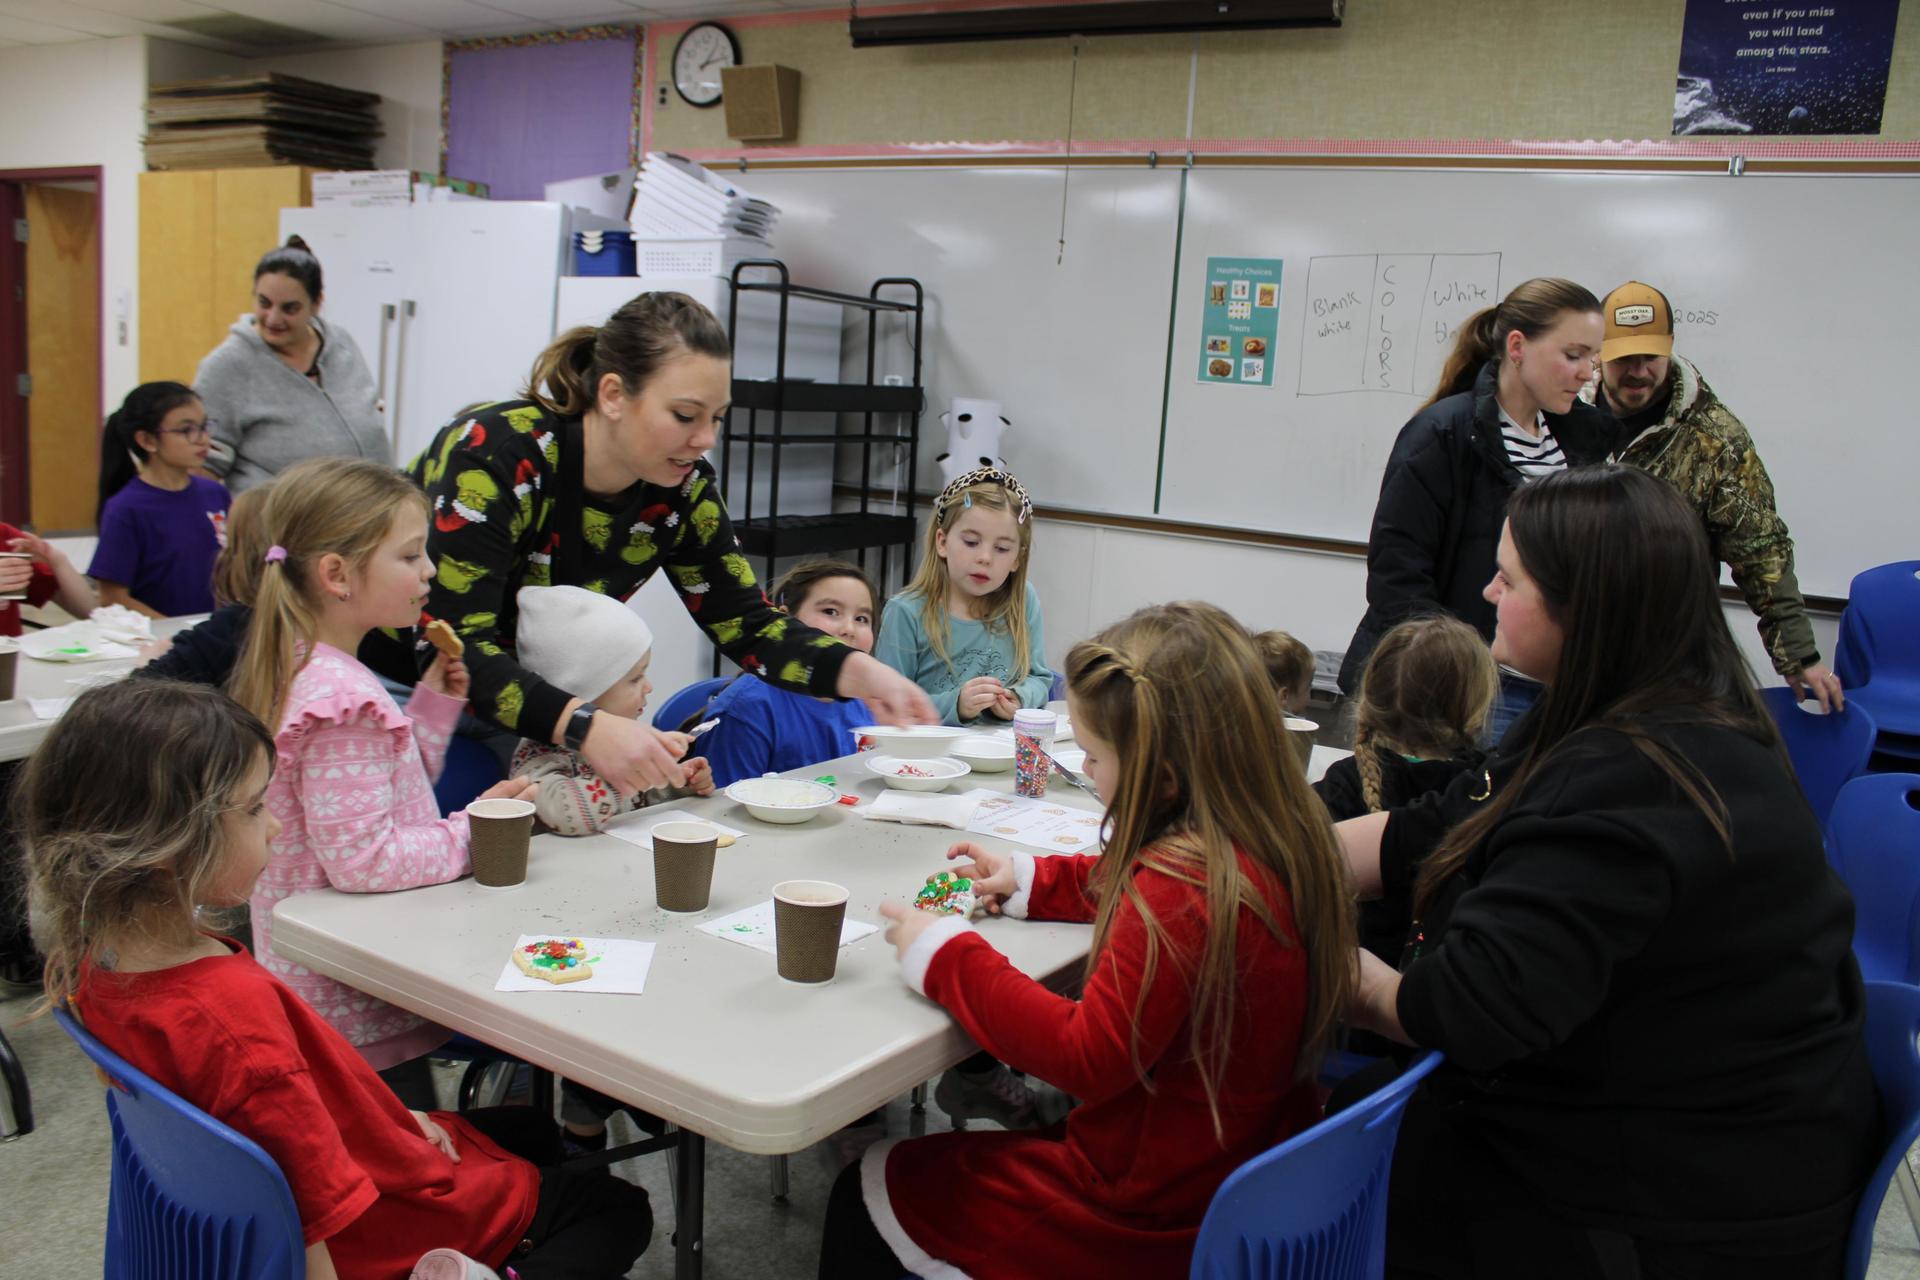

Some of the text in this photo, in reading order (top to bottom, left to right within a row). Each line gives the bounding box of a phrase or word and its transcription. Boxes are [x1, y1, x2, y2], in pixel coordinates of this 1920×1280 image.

[1742, 6, 1835, 20] even if you miss
[1749, 25, 1824, 40] you will land
[1736, 44, 1831, 58] among the stars.
[1216, 266, 1273, 277] Healthy Choices
[1618, 308, 1637, 316] MOSSY
[1673, 308, 1719, 326] 2025
[1228, 324, 1251, 333] Treats
[1317, 319, 1352, 339] white
